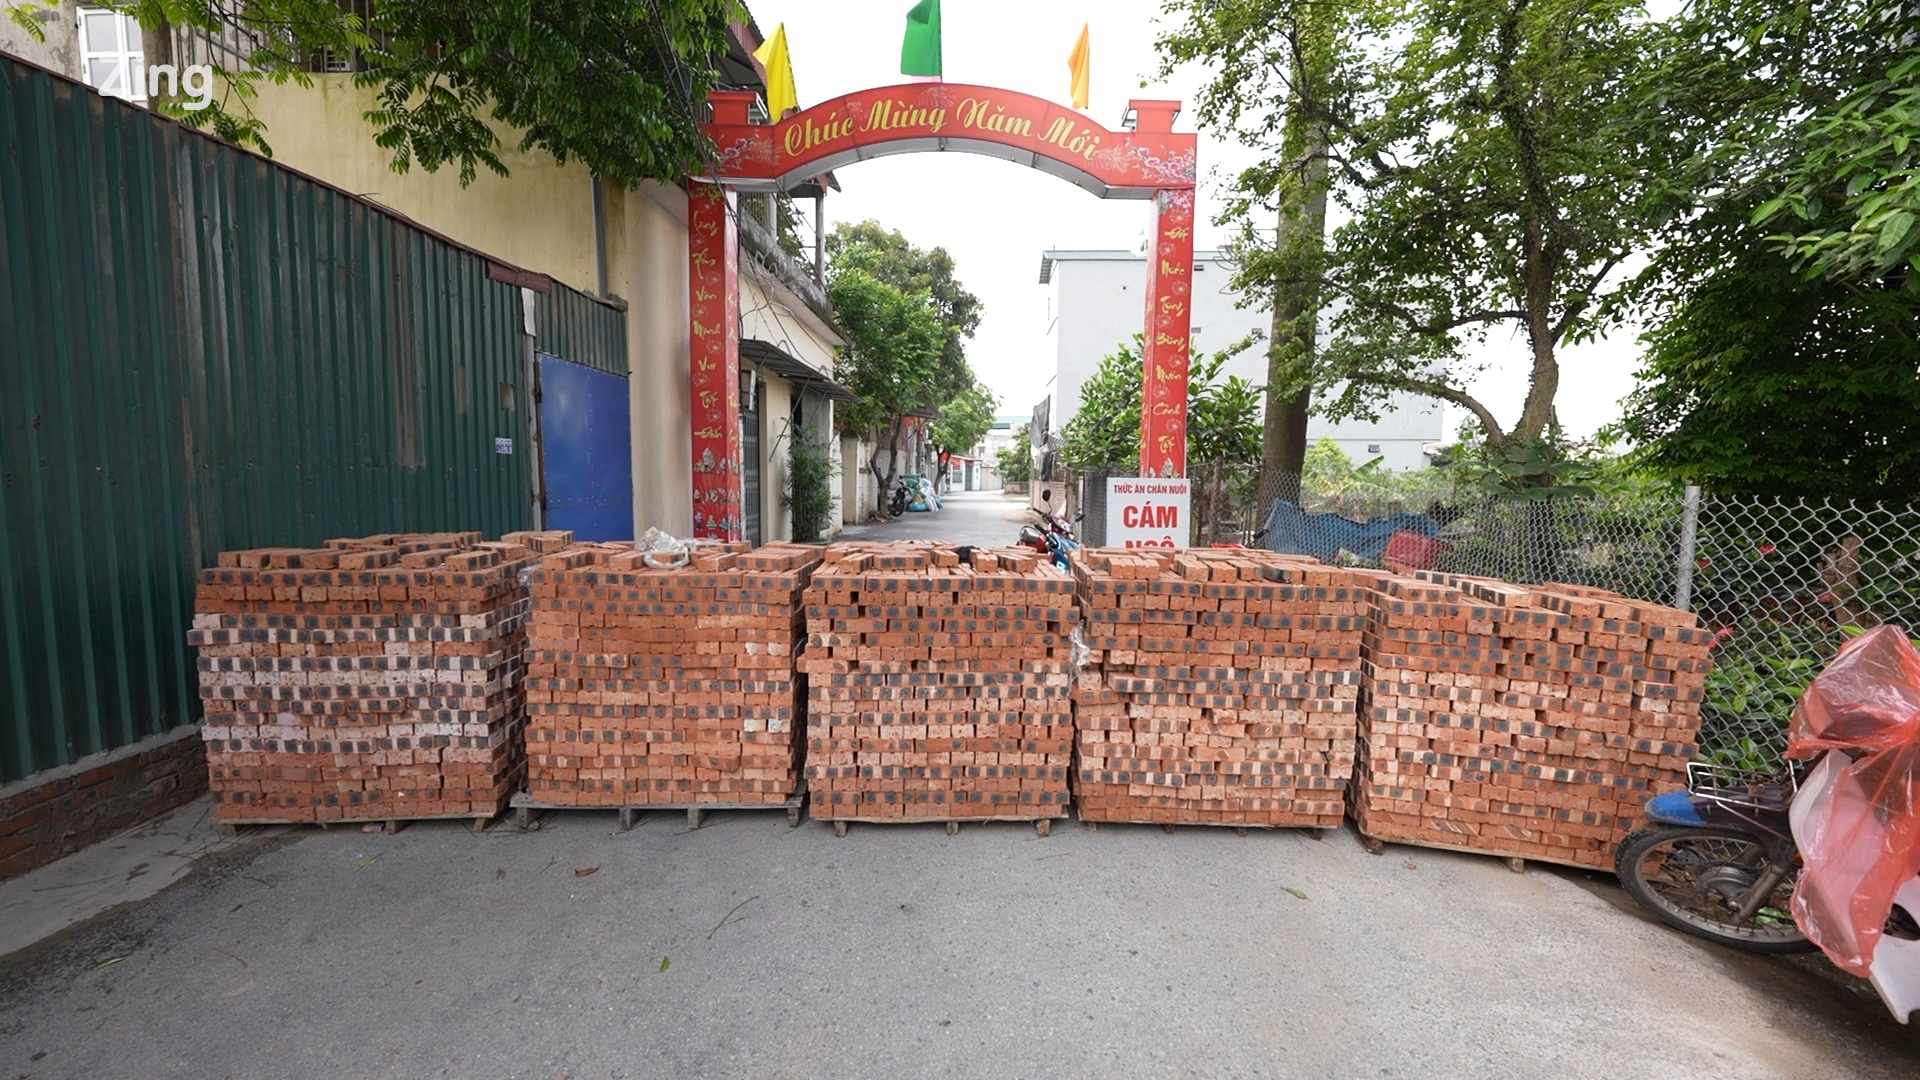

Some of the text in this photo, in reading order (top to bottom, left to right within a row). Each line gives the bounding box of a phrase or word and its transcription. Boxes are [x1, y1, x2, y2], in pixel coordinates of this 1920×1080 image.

[784, 97, 1101, 161] Chúc Mừng Năm Mới
[692, 319, 721, 340] Minh
[698, 355, 717, 372] Vui
[1123, 501, 1178, 528] CÁM
